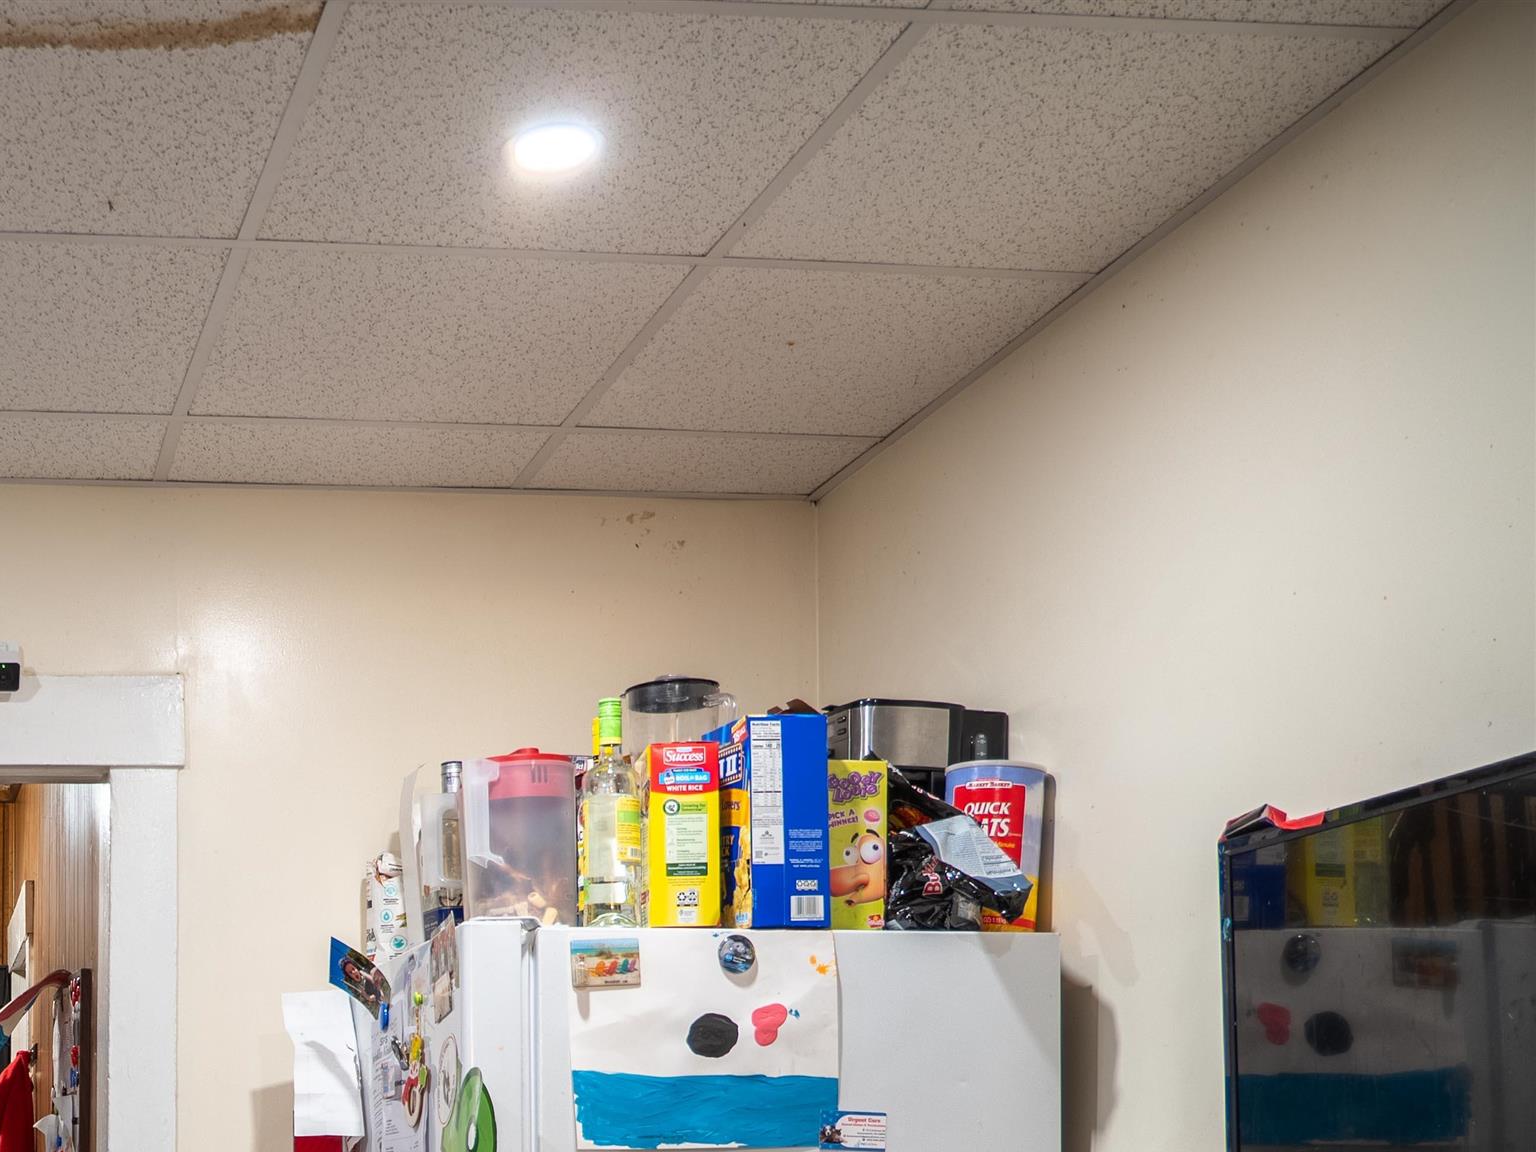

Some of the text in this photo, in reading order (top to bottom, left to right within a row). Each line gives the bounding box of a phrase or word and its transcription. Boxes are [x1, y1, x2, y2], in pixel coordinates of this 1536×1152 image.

[665, 750, 704, 763] Success
[964, 801, 1011, 818] QUICK
[981, 818, 1010, 837] ATS
